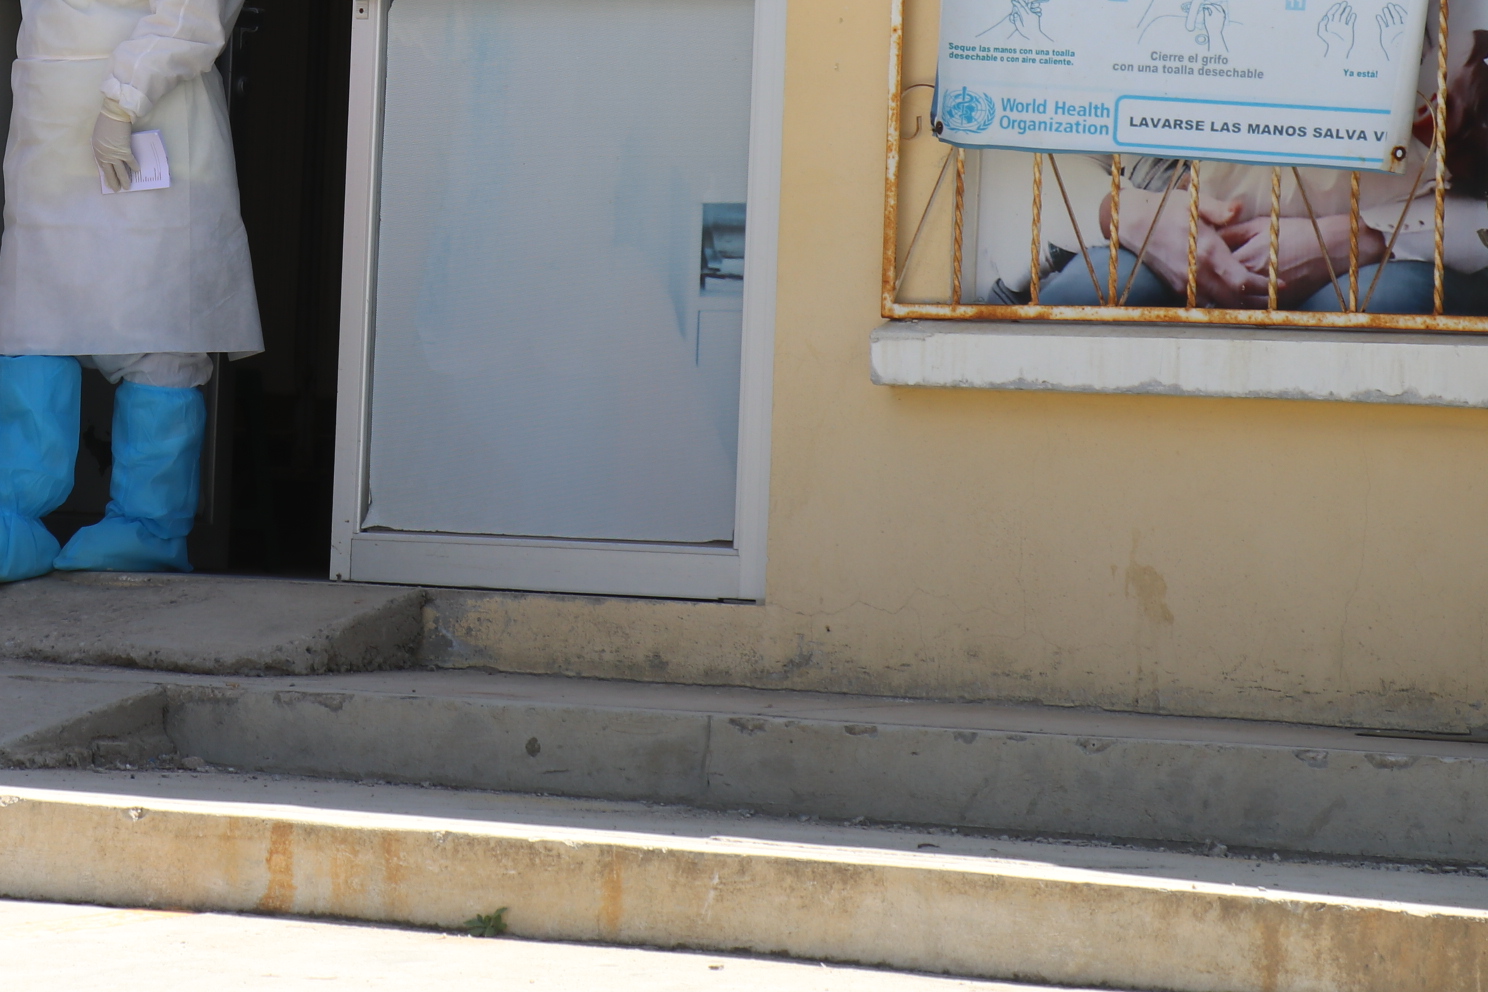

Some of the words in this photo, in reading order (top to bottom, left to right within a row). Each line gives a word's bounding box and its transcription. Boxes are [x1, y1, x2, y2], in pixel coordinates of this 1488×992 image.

[1150, 50, 1184, 62] Cierre
[1188, 53, 1198, 63] el
[1201, 54, 1228, 67] grifo
[1112, 63, 1133, 71] con
[1137, 64, 1158, 73] una
[1162, 64, 1193, 75] toalla
[1197, 63, 1263, 78] desechable
[1343, 68, 1354, 76] Ya
[1001, 98, 1046, 114] World
[1054, 101, 1110, 117] Health
[999, 115, 1109, 134] Organization
[1129, 116, 1204, 131] LAVARSE
[1210, 121, 1241, 133] LAS
[1247, 123, 1306, 137] MANOS
[1312, 127, 1367, 140] SALVA
